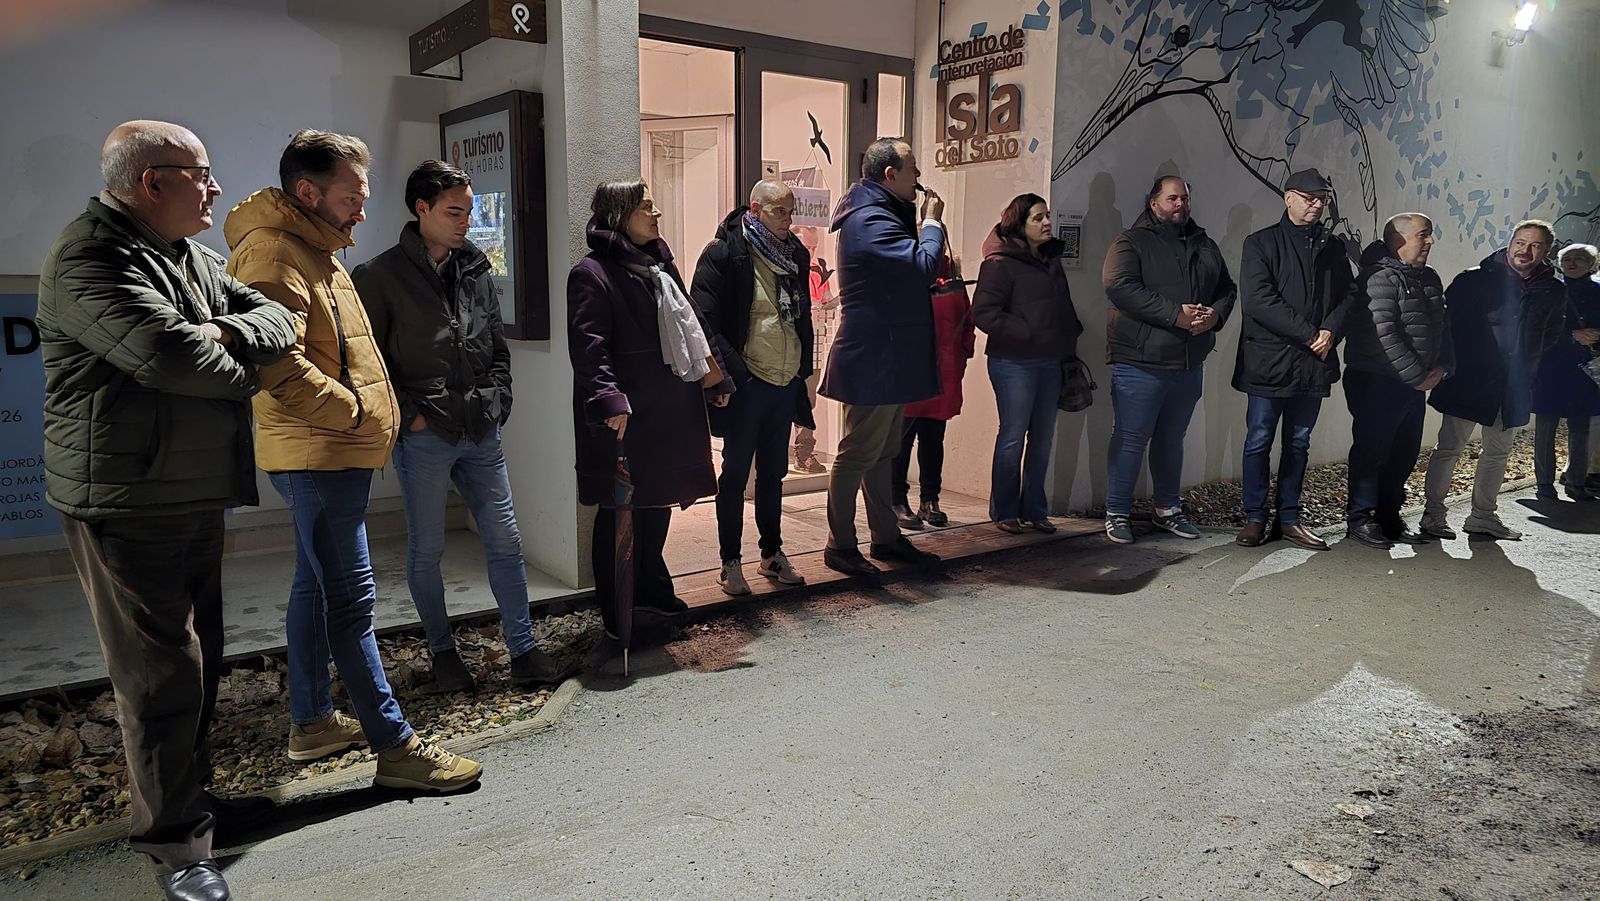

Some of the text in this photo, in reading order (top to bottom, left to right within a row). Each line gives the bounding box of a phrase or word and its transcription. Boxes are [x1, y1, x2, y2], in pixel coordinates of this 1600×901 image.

[938, 24, 1025, 62] Centro de
[936, 71, 1022, 143] Isla
[476, 155, 504, 174] HORAS
[935, 135, 1019, 168] del Soto
[792, 197, 829, 218] Abierto
